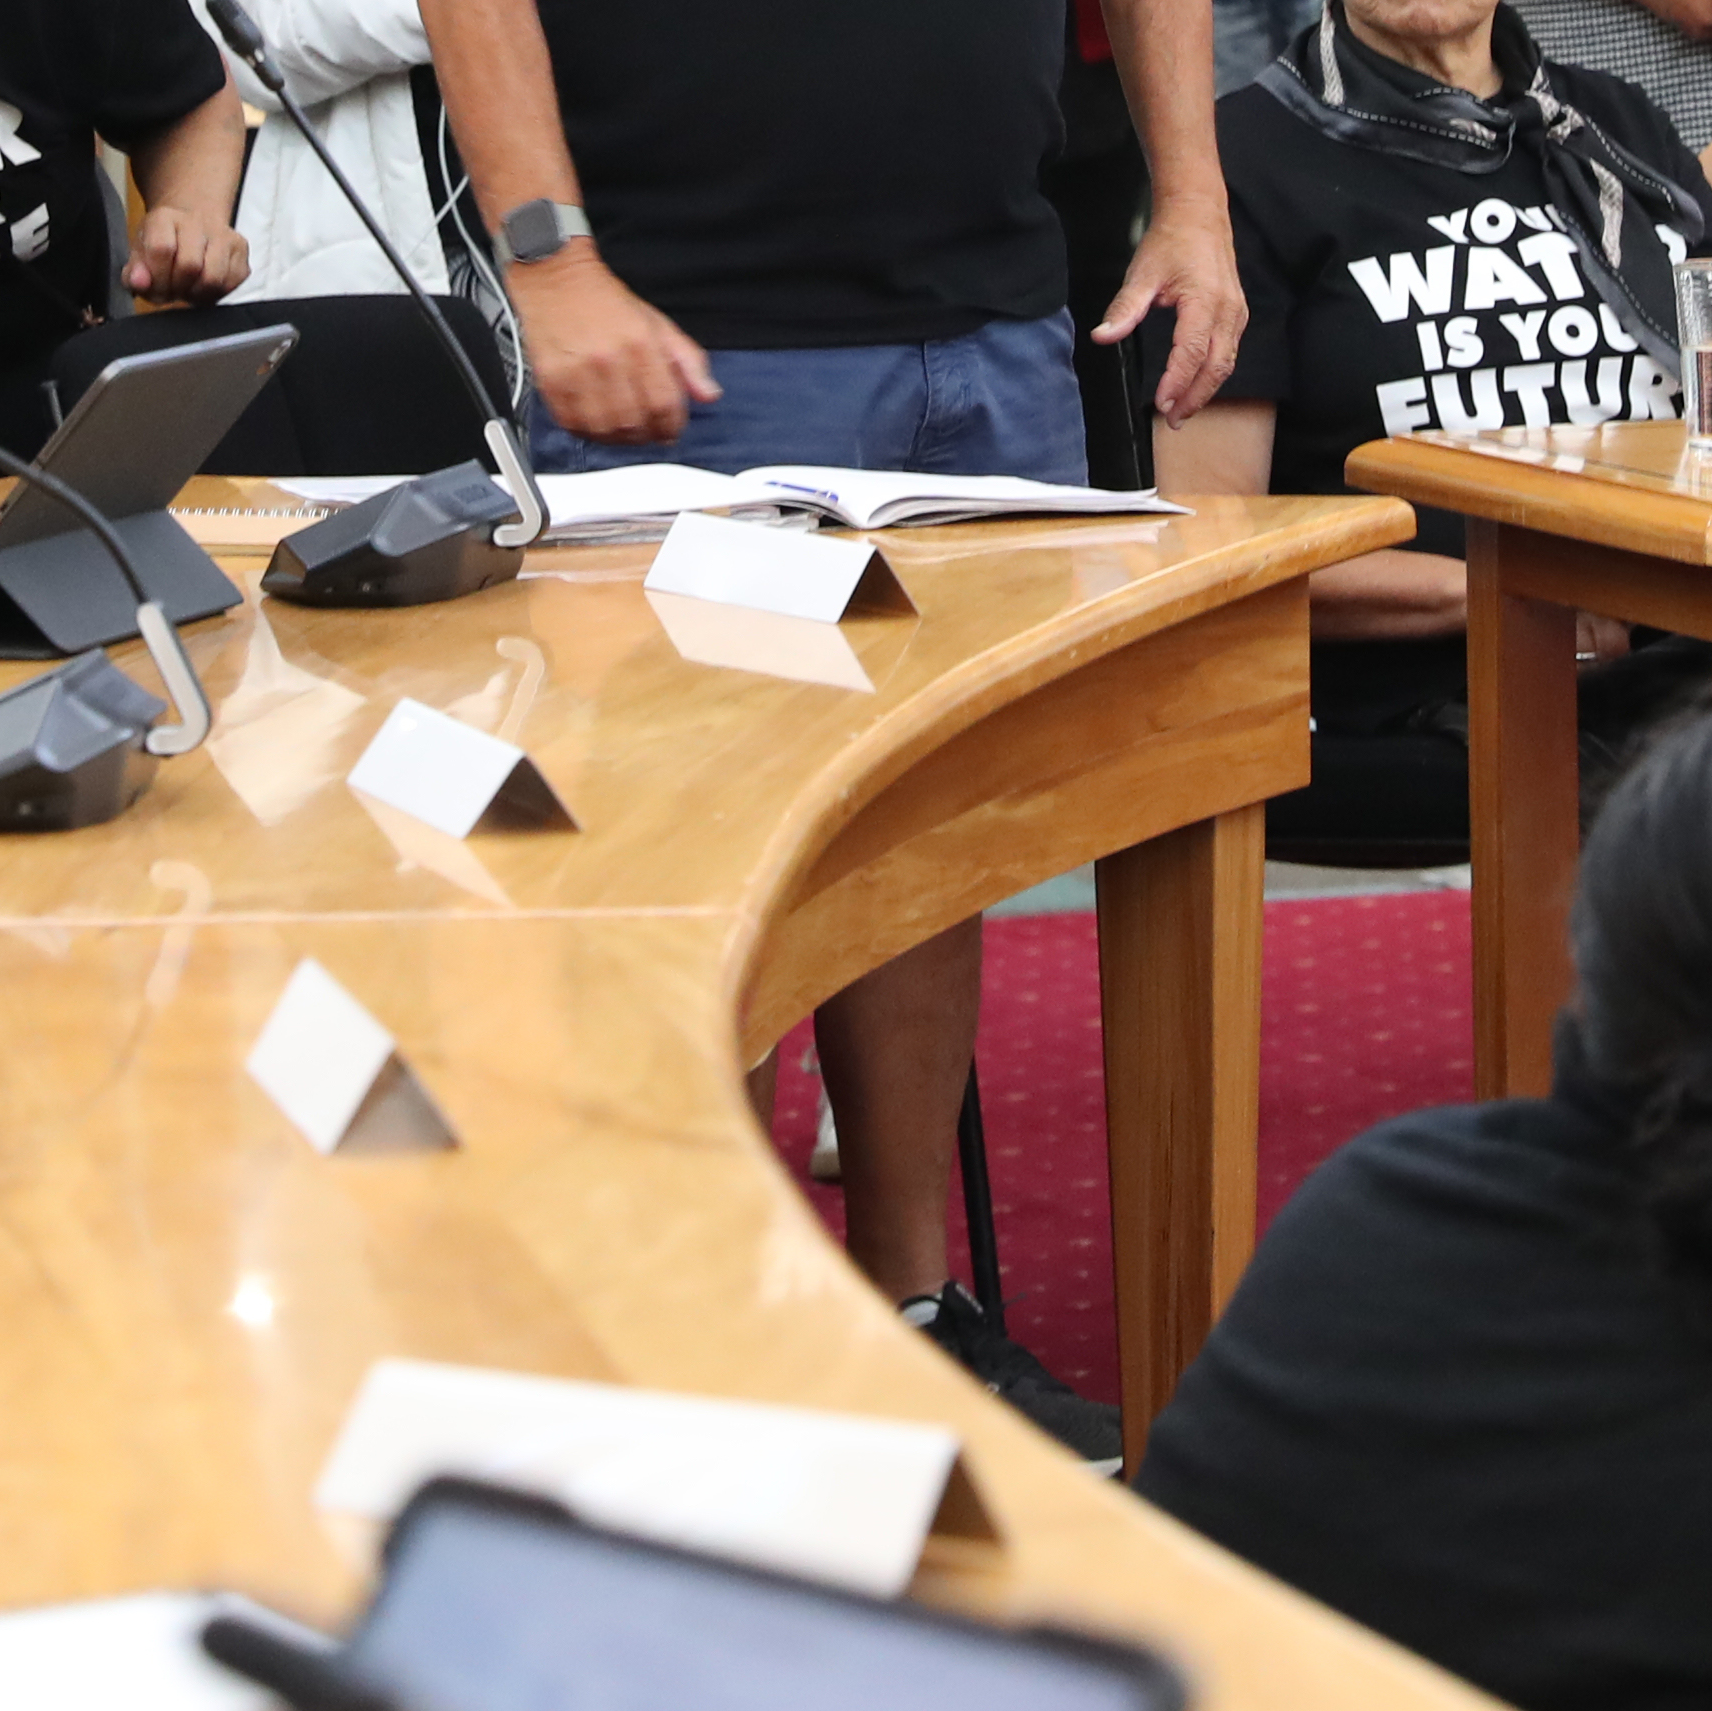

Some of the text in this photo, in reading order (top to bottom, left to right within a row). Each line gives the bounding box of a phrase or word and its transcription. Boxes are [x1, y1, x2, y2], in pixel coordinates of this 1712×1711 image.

[1347, 230, 1587, 324] WAT
[1415, 304, 1639, 372] IS YOU
[1376, 354, 1686, 439] FUTUR
